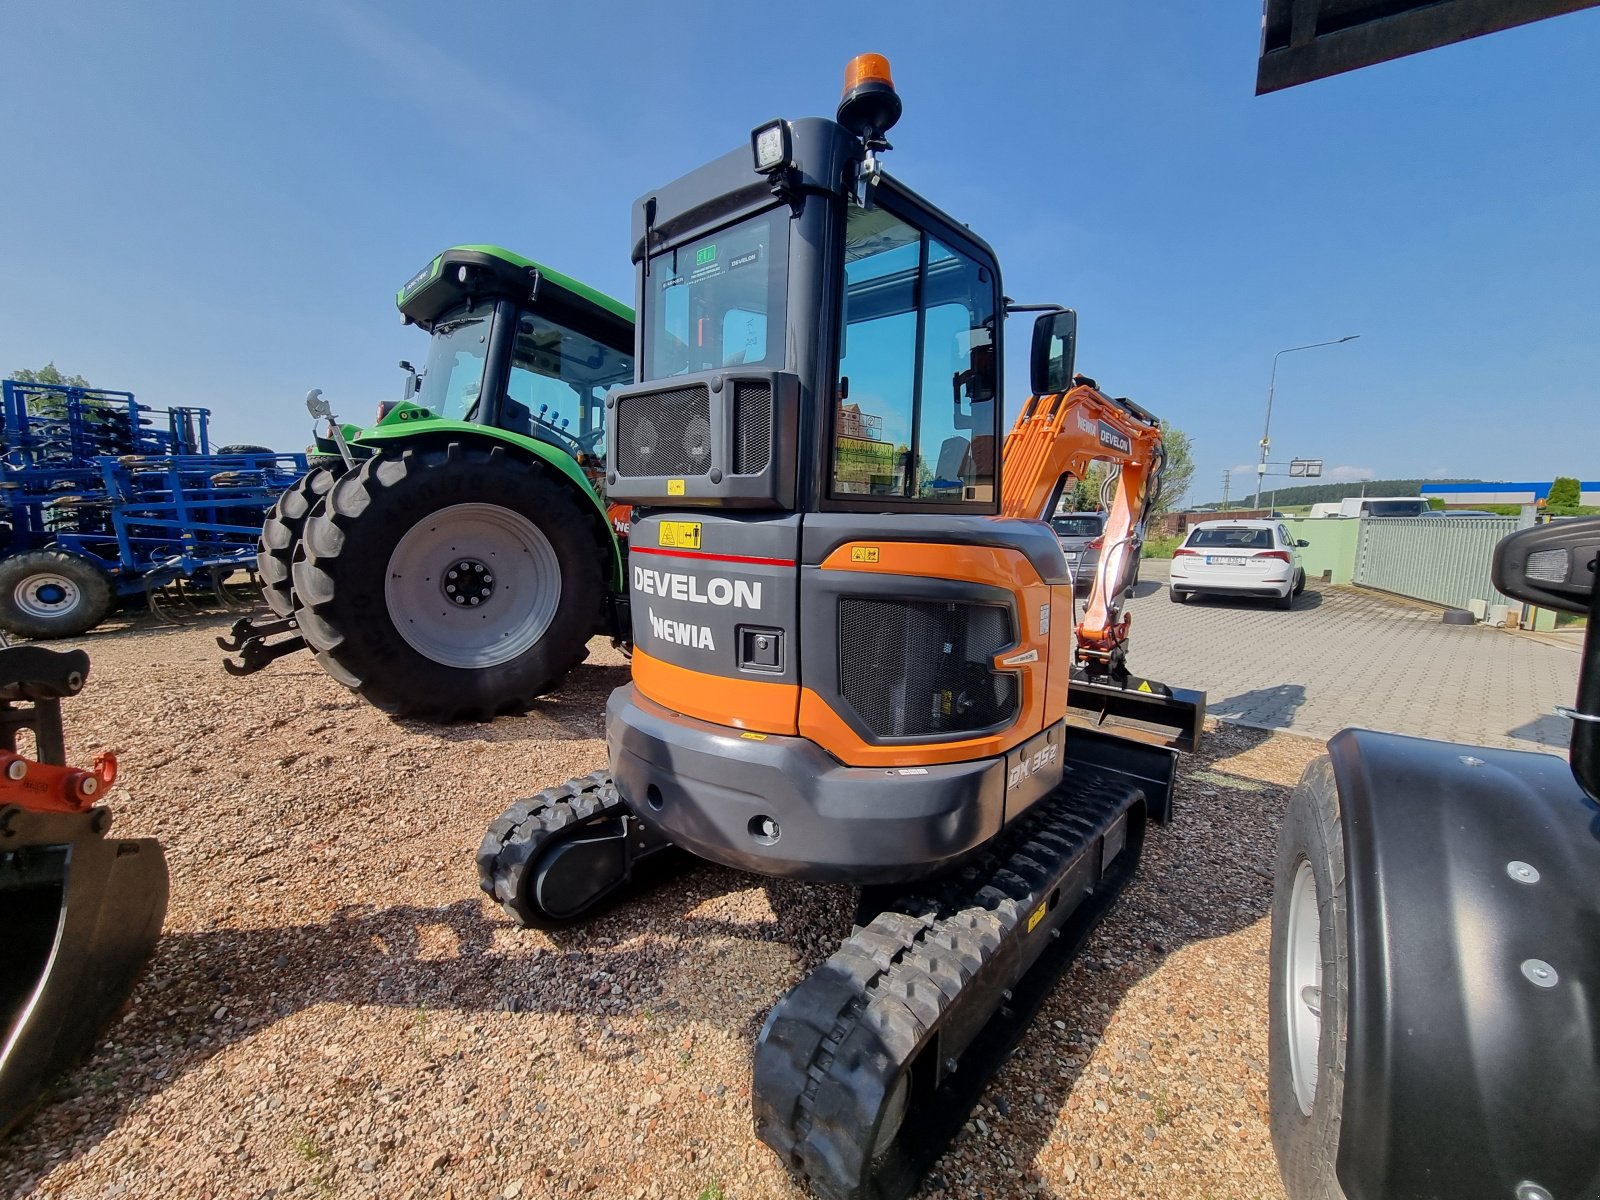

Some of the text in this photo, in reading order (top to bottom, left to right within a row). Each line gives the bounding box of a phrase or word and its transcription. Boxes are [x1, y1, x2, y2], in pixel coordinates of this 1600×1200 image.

[1100, 429, 1129, 452] DEVELON
[634, 566, 762, 610] DEVELON
[649, 606, 715, 651] NEWIA
